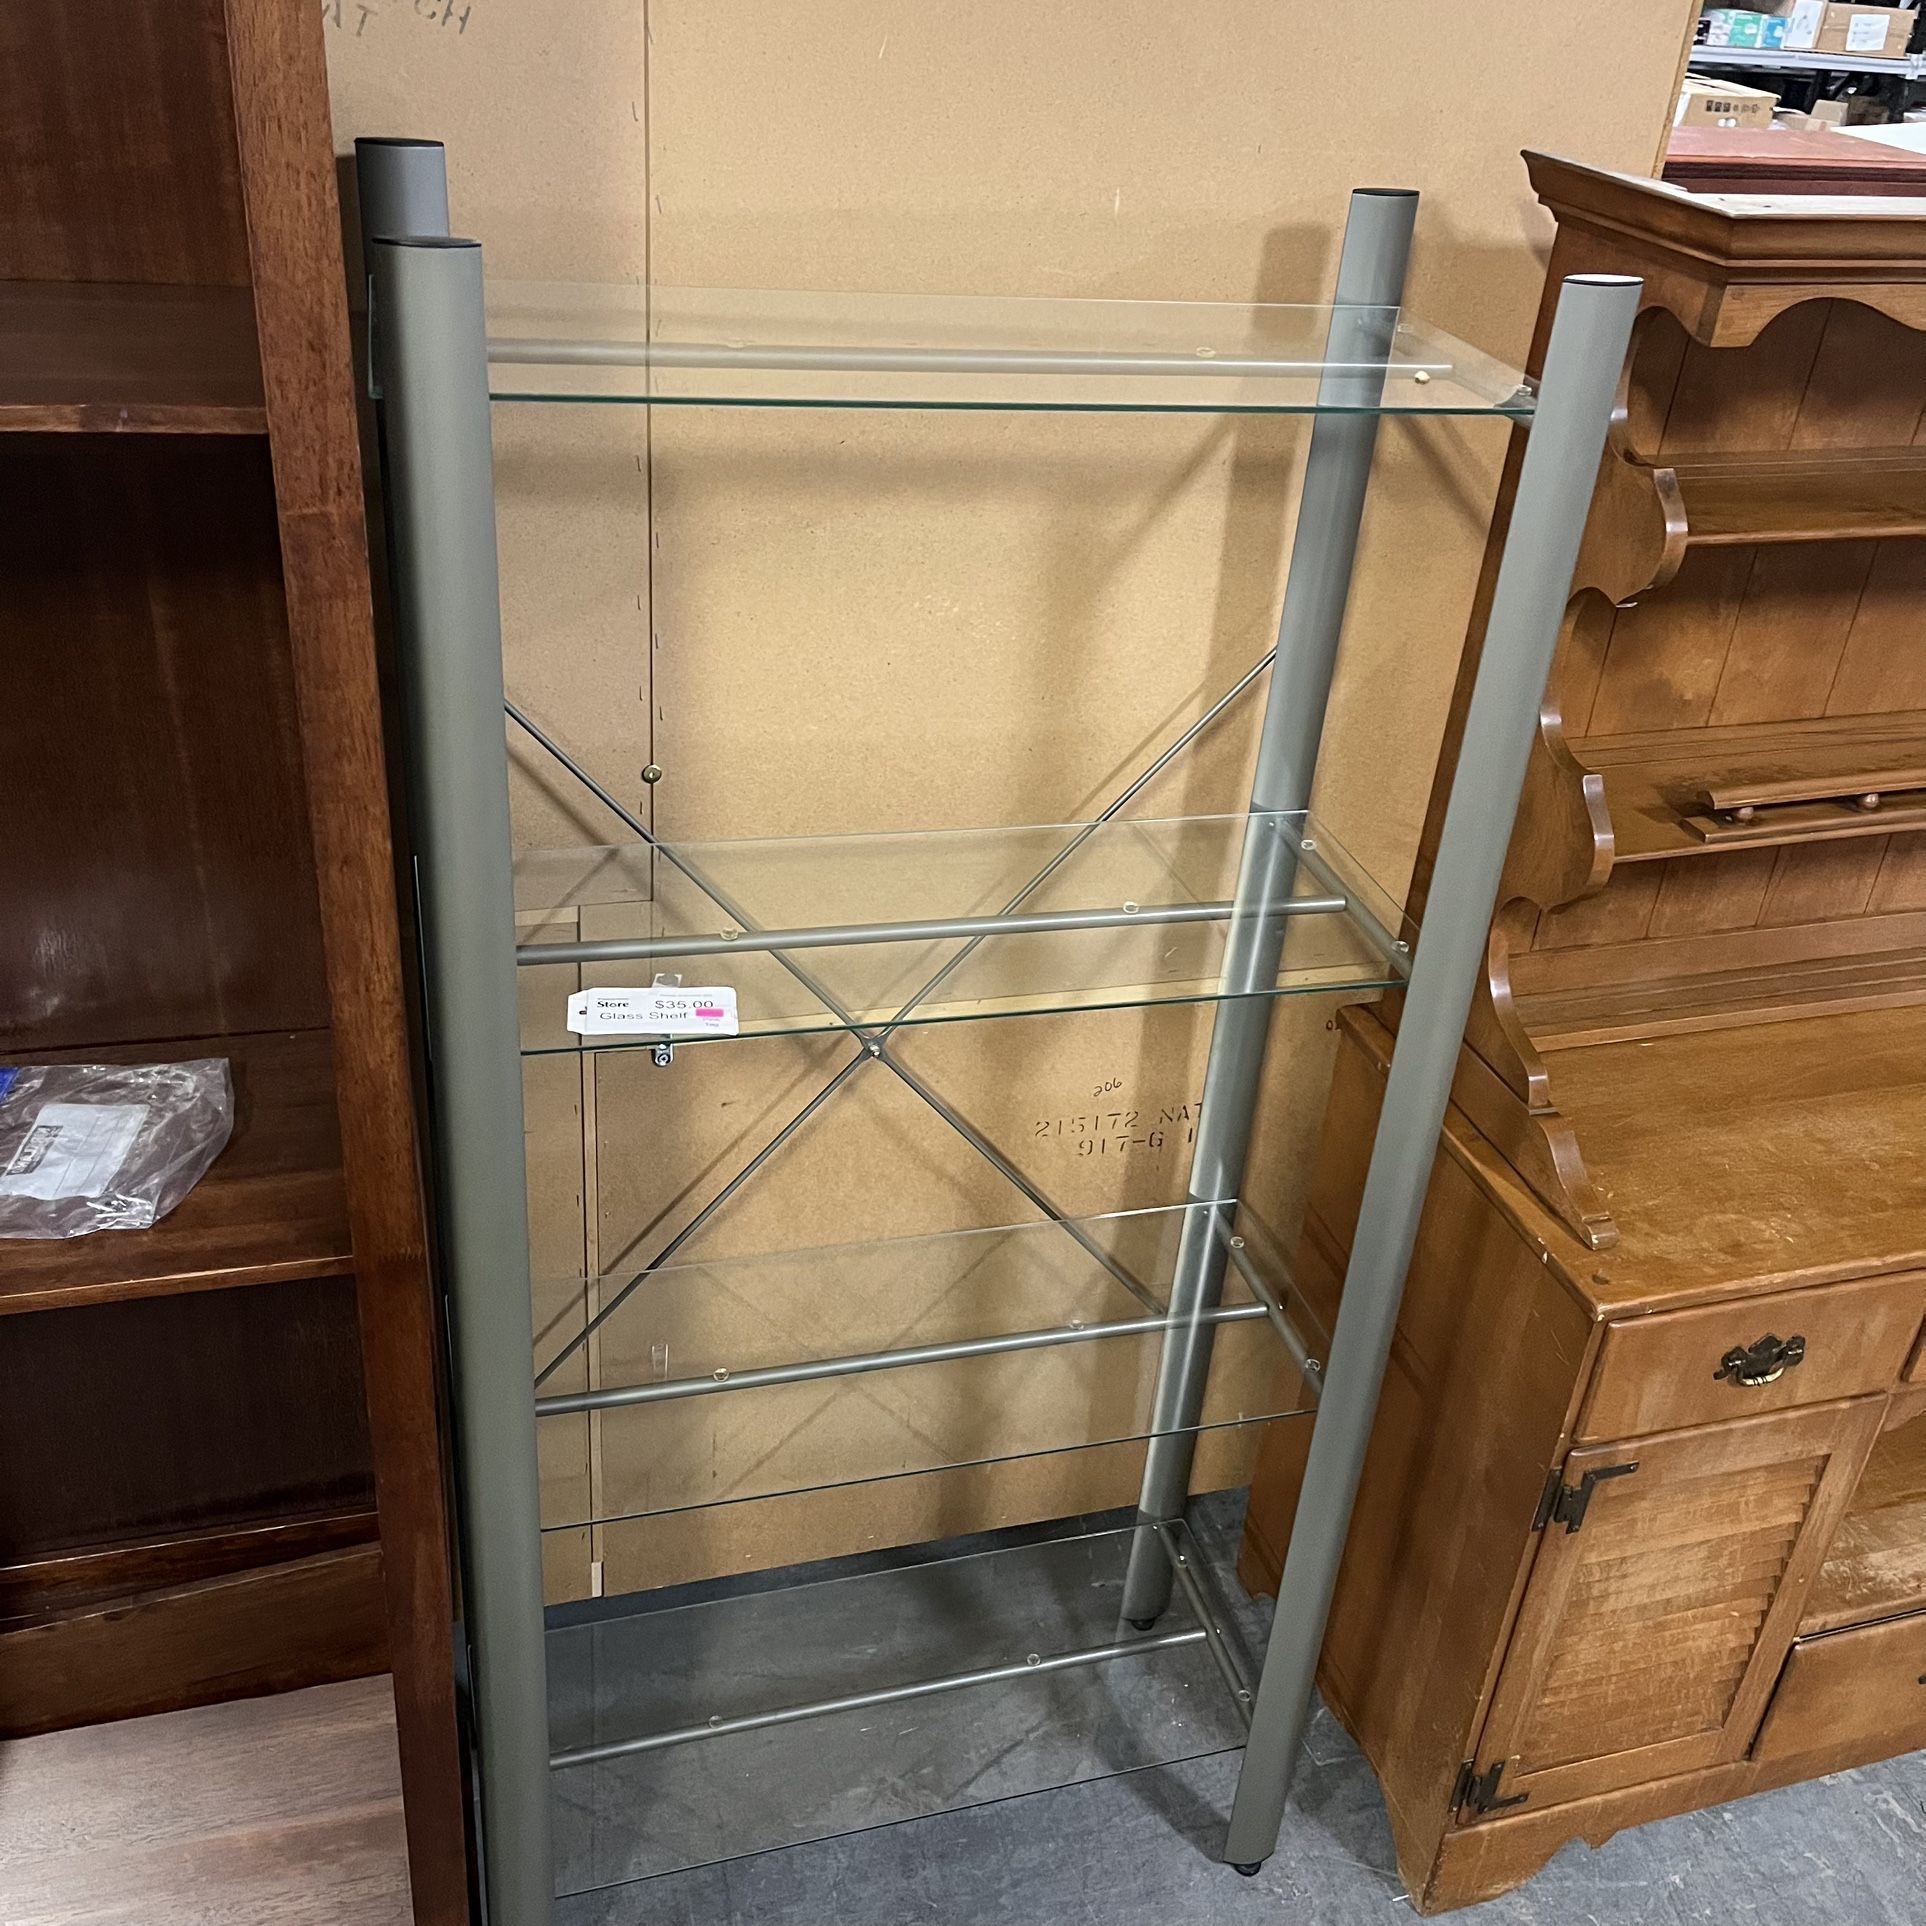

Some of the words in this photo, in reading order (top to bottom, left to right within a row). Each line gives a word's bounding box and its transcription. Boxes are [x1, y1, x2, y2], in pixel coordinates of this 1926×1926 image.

[597, 1001, 630, 1009] Store
[654, 1000, 714, 1009] $35.00
[599, 1012, 644, 1020] Glass
[649, 1011, 689, 1020] Shelf
[1093, 1077, 1123, 1097] 206
[1034, 1111, 1139, 1137] 215172
